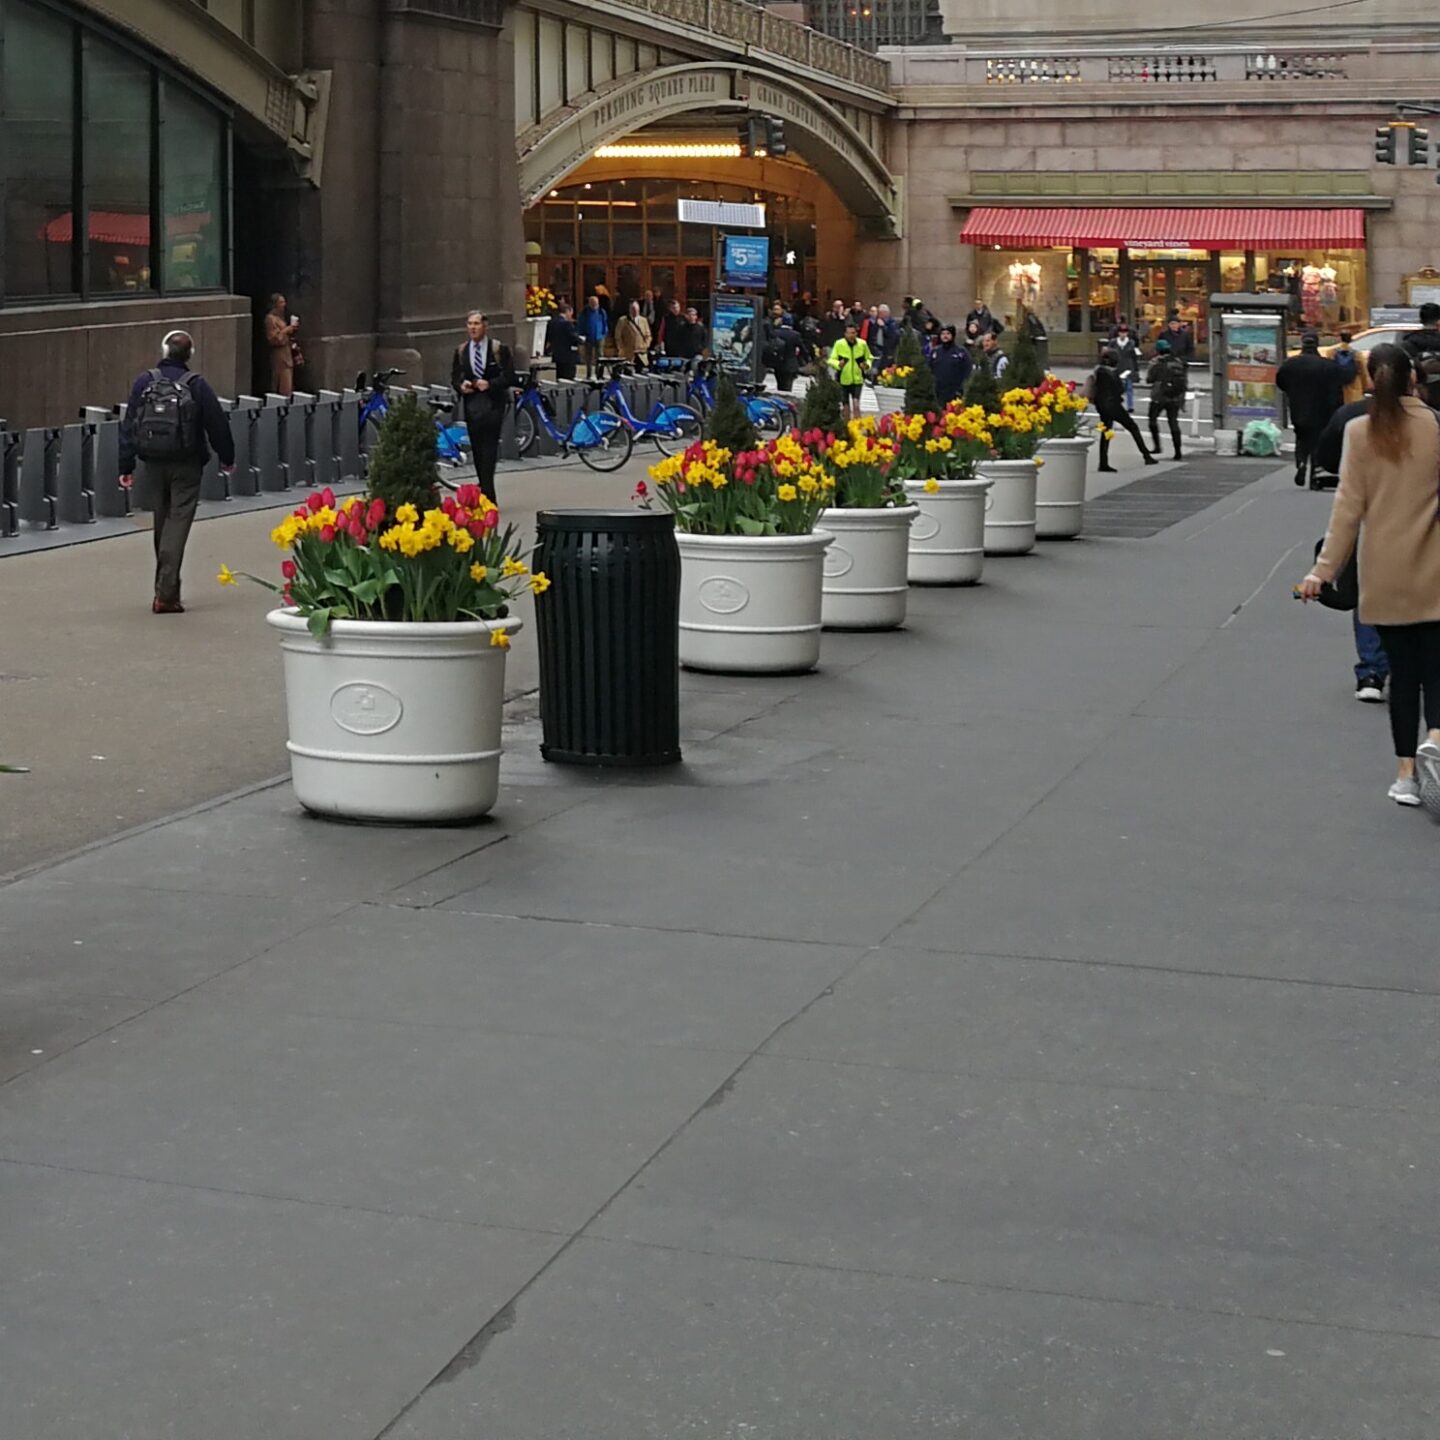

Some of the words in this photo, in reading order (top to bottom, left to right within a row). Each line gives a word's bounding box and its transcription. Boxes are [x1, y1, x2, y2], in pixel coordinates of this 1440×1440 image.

[594, 89, 644, 128] PERSHING
[649, 78, 684, 104] SQUARE
[688, 76, 716, 93] PLAZA
[757, 86, 783, 109] GRAND
[787, 99, 819, 130] CENTRAL
[1124, 240, 1164, 249] vineyard
